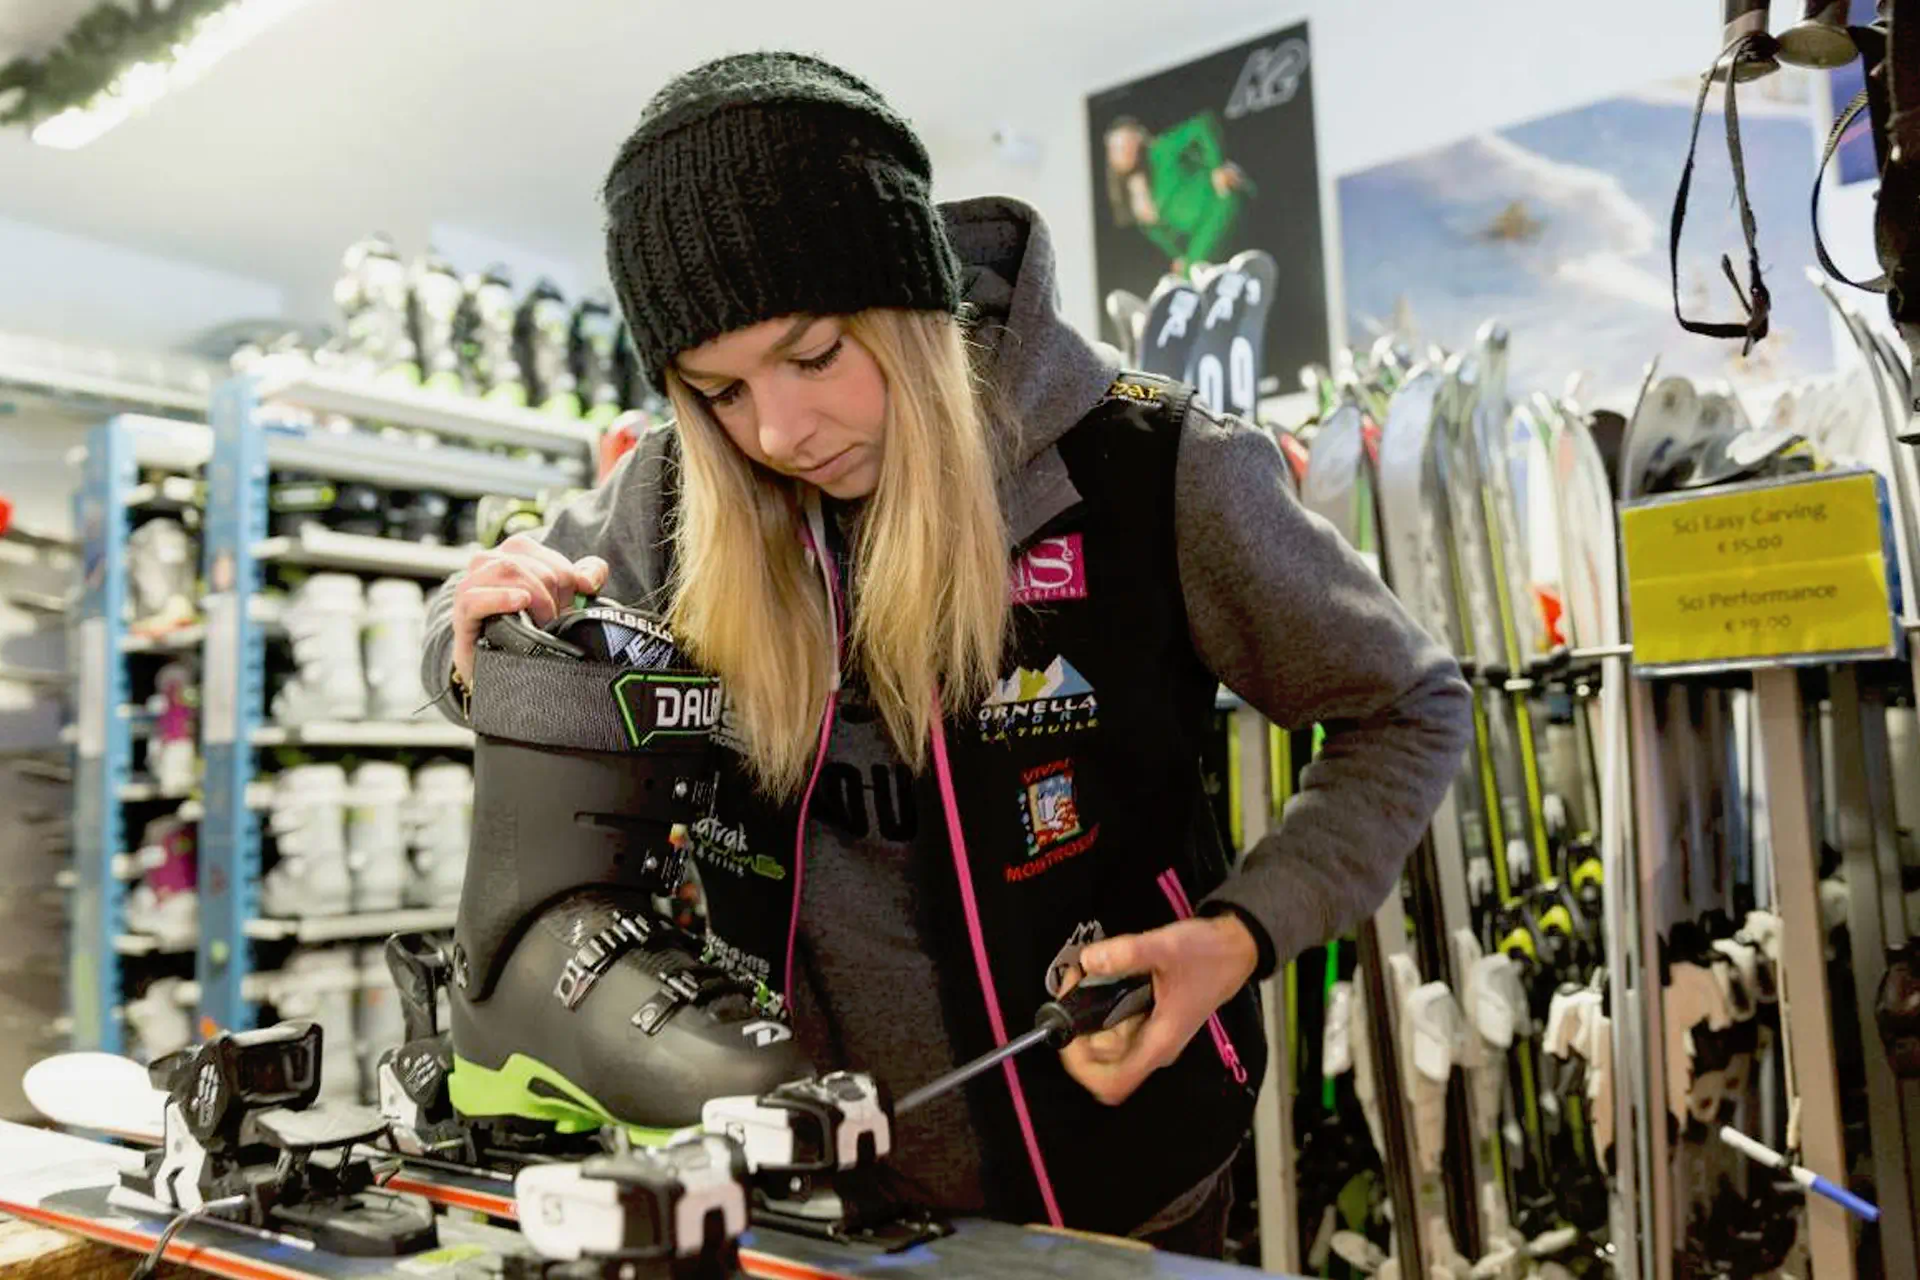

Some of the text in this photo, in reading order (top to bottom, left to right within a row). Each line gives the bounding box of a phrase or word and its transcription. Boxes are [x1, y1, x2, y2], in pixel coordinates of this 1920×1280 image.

[1704, 513, 1746, 531] Easy
[1752, 503, 1828, 526] Carving
[1709, 584, 1838, 608] Performance
[979, 695, 1098, 721] ORNELLA
